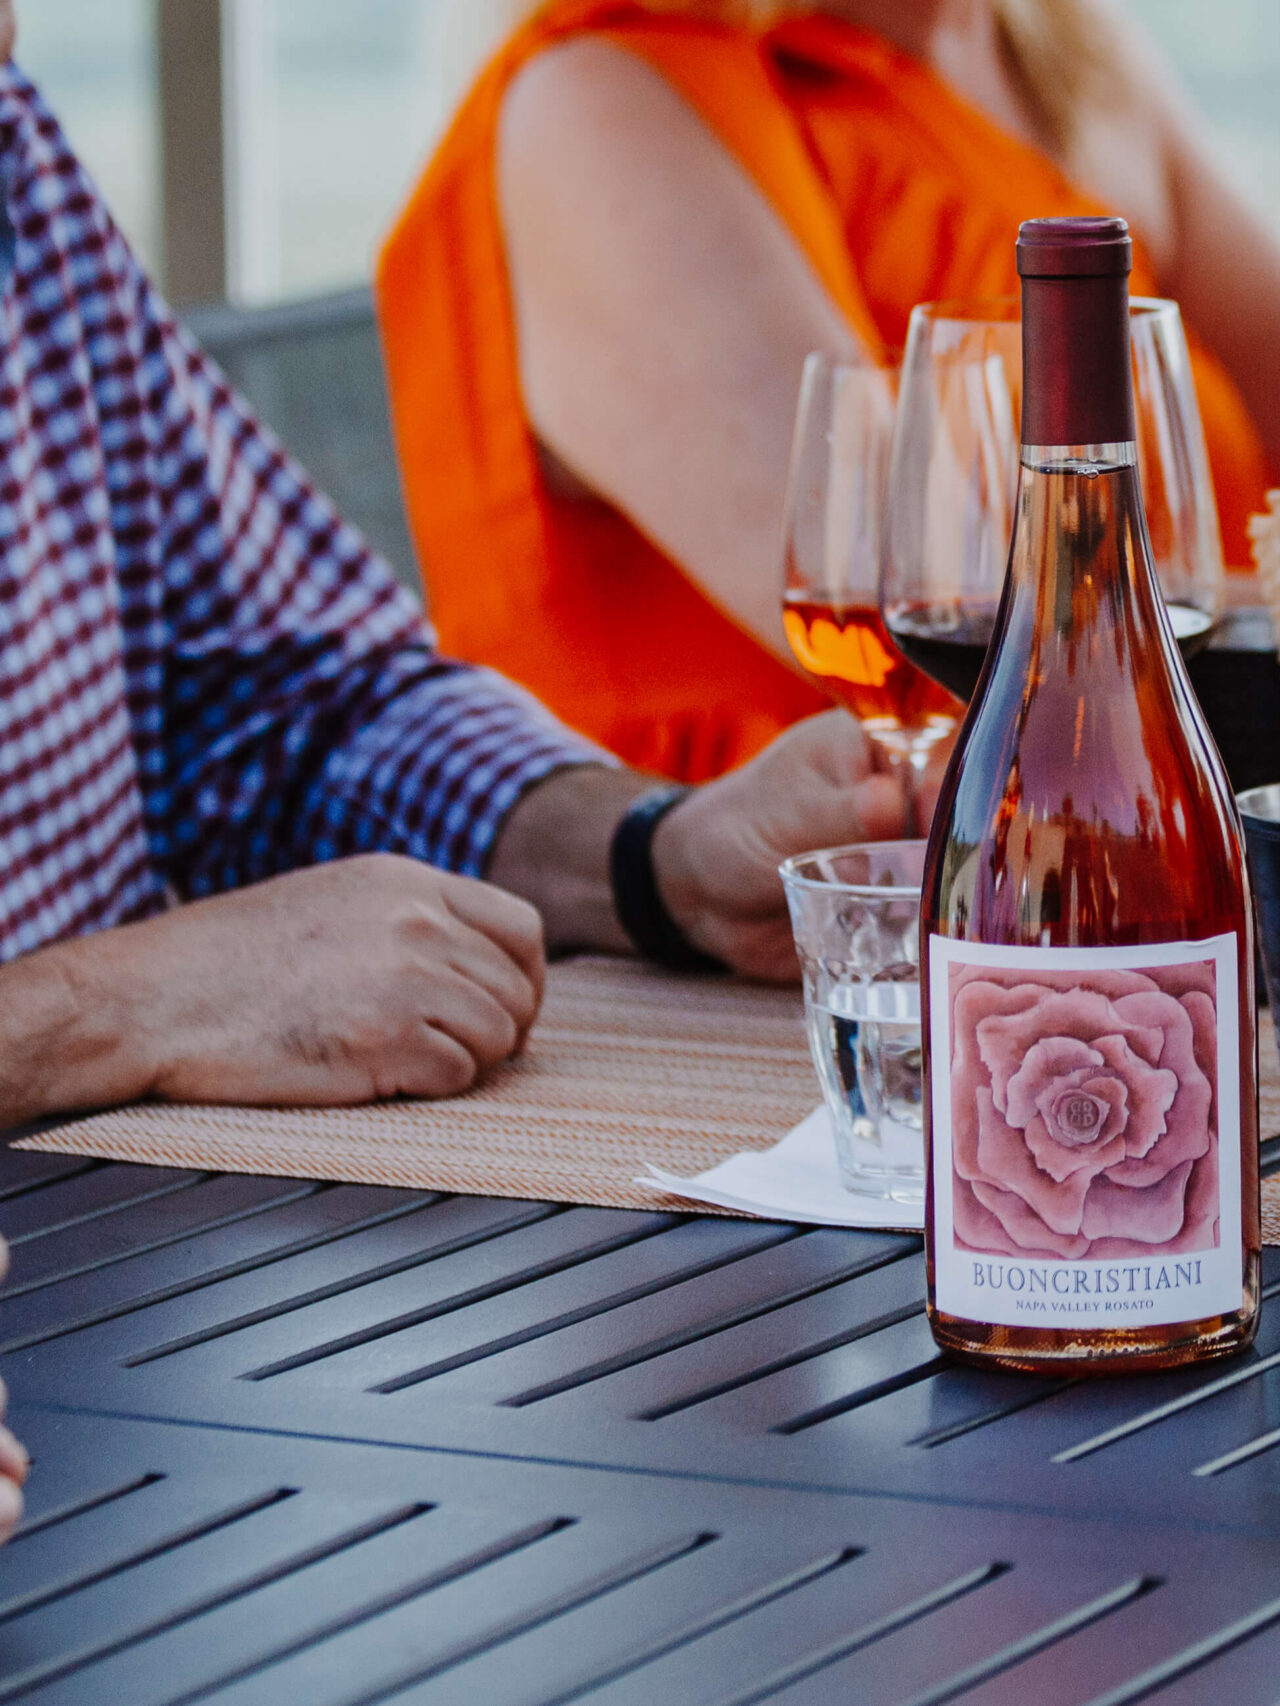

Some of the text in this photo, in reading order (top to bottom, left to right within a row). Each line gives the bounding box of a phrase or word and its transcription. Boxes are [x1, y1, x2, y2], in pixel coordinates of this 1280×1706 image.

[972, 1260, 1203, 1294] BUONCRISTIANI
[1015, 1299, 1155, 1313] NAPA VALLEY ROSATO
